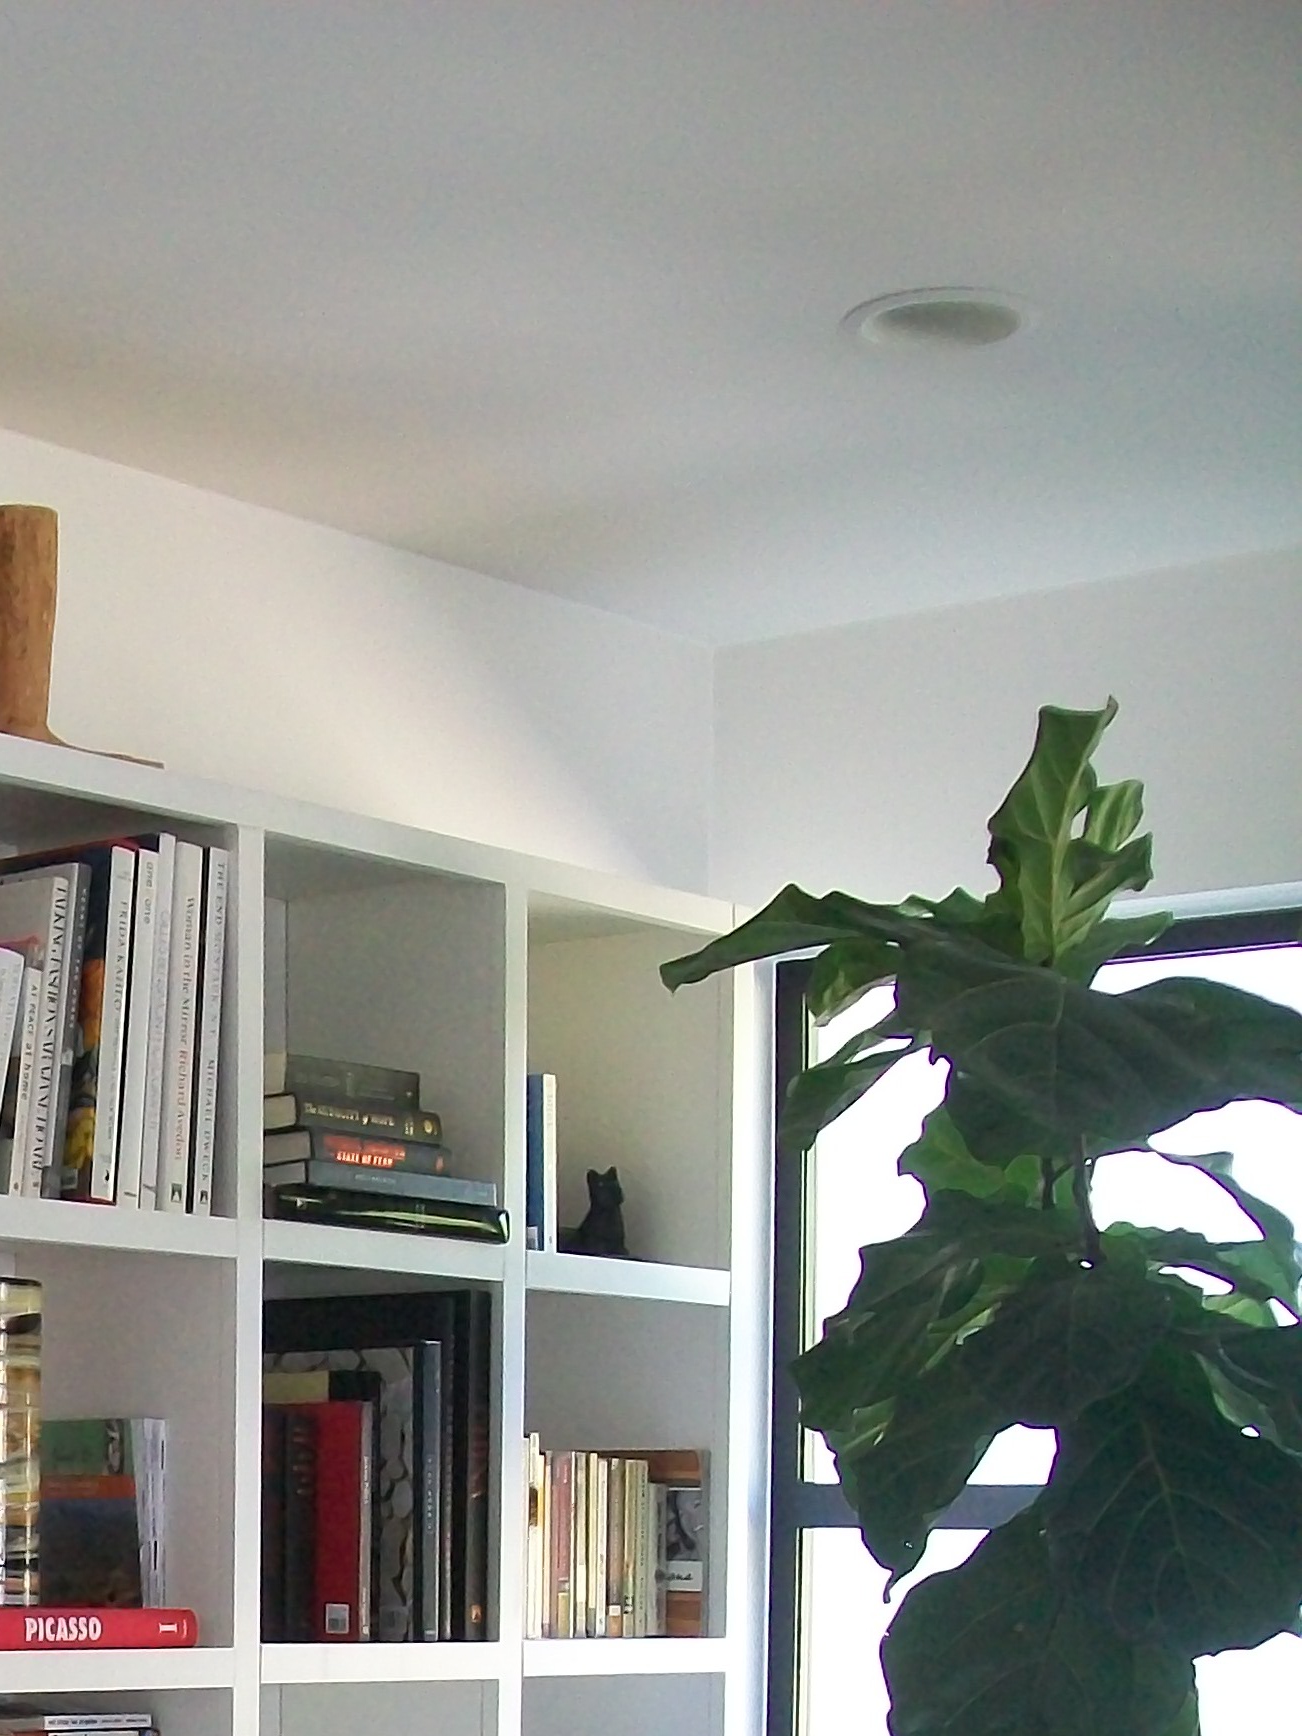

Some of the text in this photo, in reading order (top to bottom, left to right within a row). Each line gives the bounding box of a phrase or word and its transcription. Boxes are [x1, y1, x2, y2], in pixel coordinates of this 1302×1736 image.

[213, 896, 225, 926] END
[112, 953, 126, 1013] KAHLO
[172, 896, 197, 1161] Woman in the Mirror Richard Avedon
[24, 1616, 102, 1642] PICASSO
